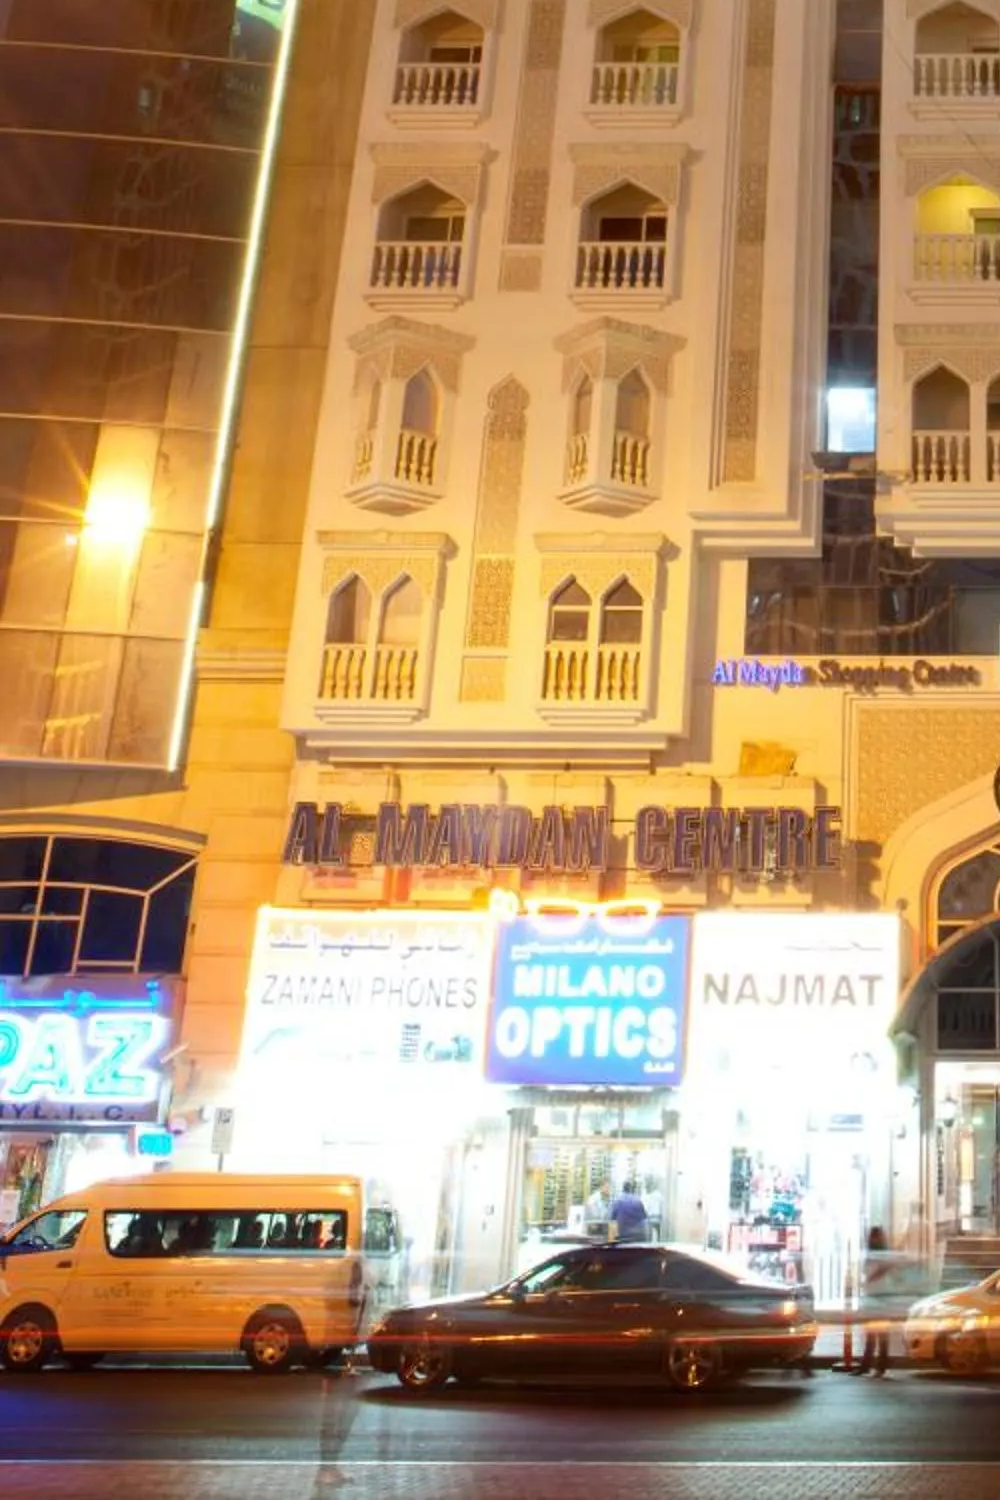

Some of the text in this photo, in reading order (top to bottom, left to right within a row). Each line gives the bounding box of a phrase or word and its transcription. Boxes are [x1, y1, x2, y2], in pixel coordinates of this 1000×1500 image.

[713, 659, 737, 686] Al
[283, 801, 844, 873] AL MAYDAN CENTRE
[260, 973, 479, 1009] ZAMANI PHONES
[513, 964, 666, 998] MILANO
[702, 971, 885, 1007] NAJMAT
[495, 1005, 678, 1059] OPTICS
